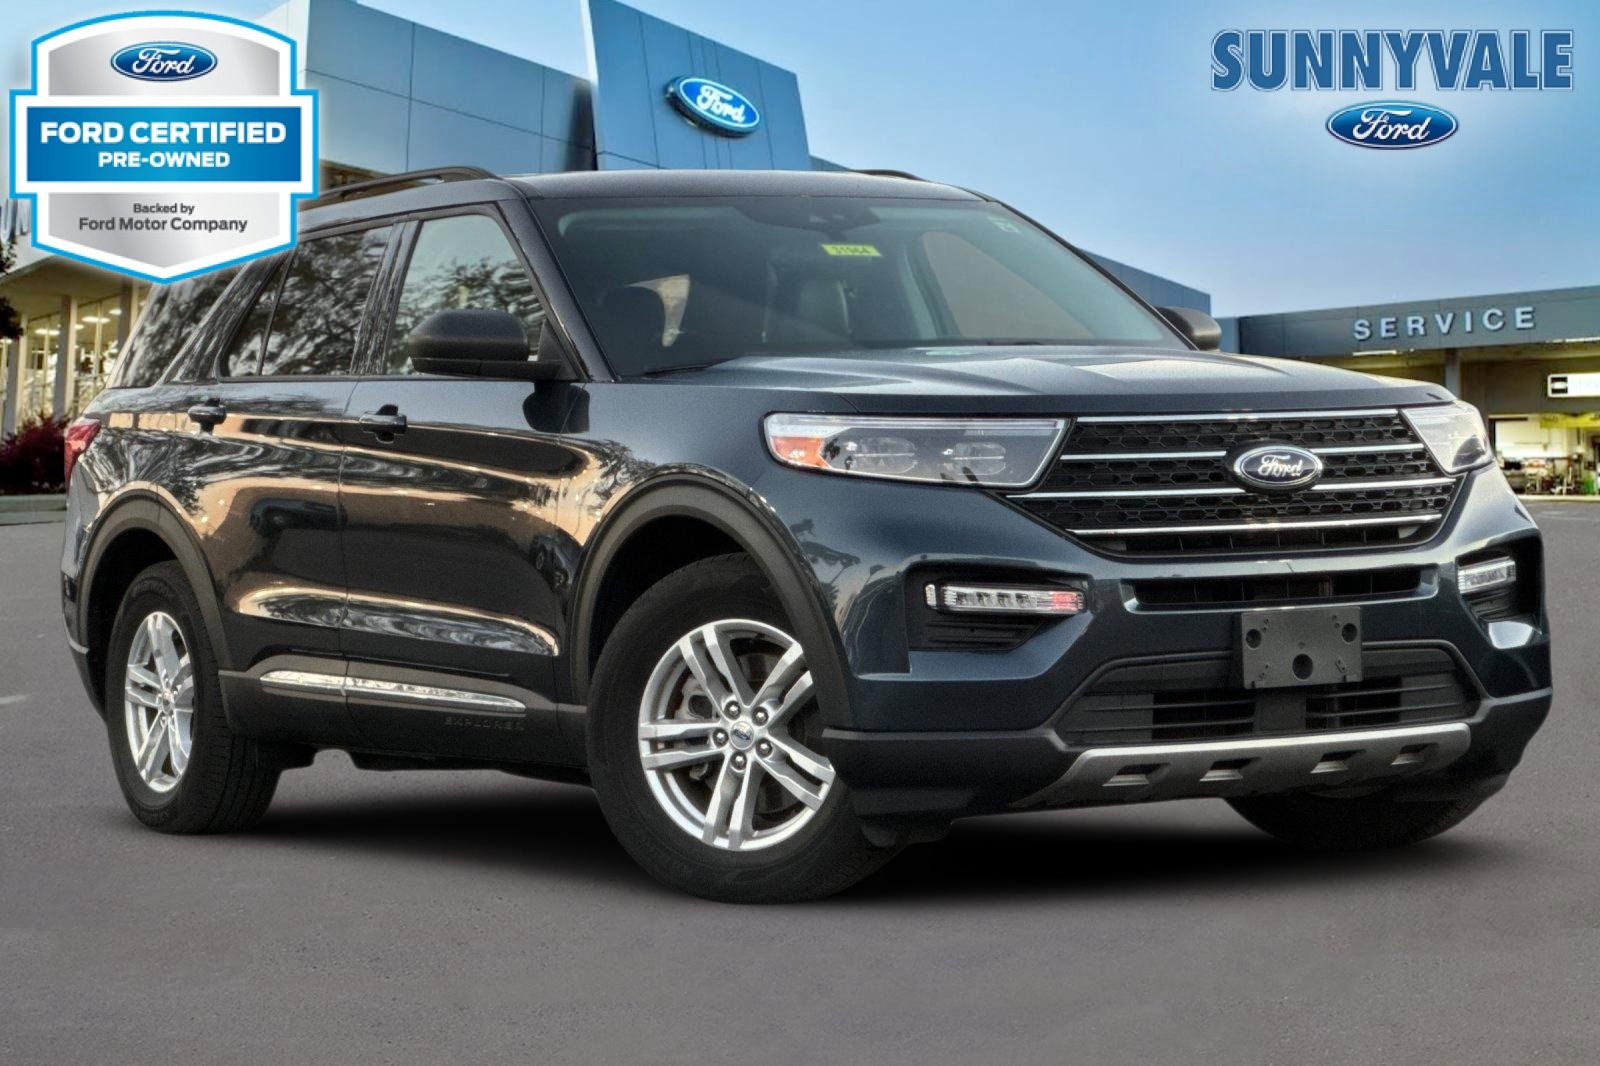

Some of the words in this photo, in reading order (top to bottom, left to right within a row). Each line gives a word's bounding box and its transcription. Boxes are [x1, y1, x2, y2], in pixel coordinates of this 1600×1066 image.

[696, 84, 746, 123] Ford
[1353, 306, 1535, 341] SERVICE
[1257, 454, 1303, 477] Ford
